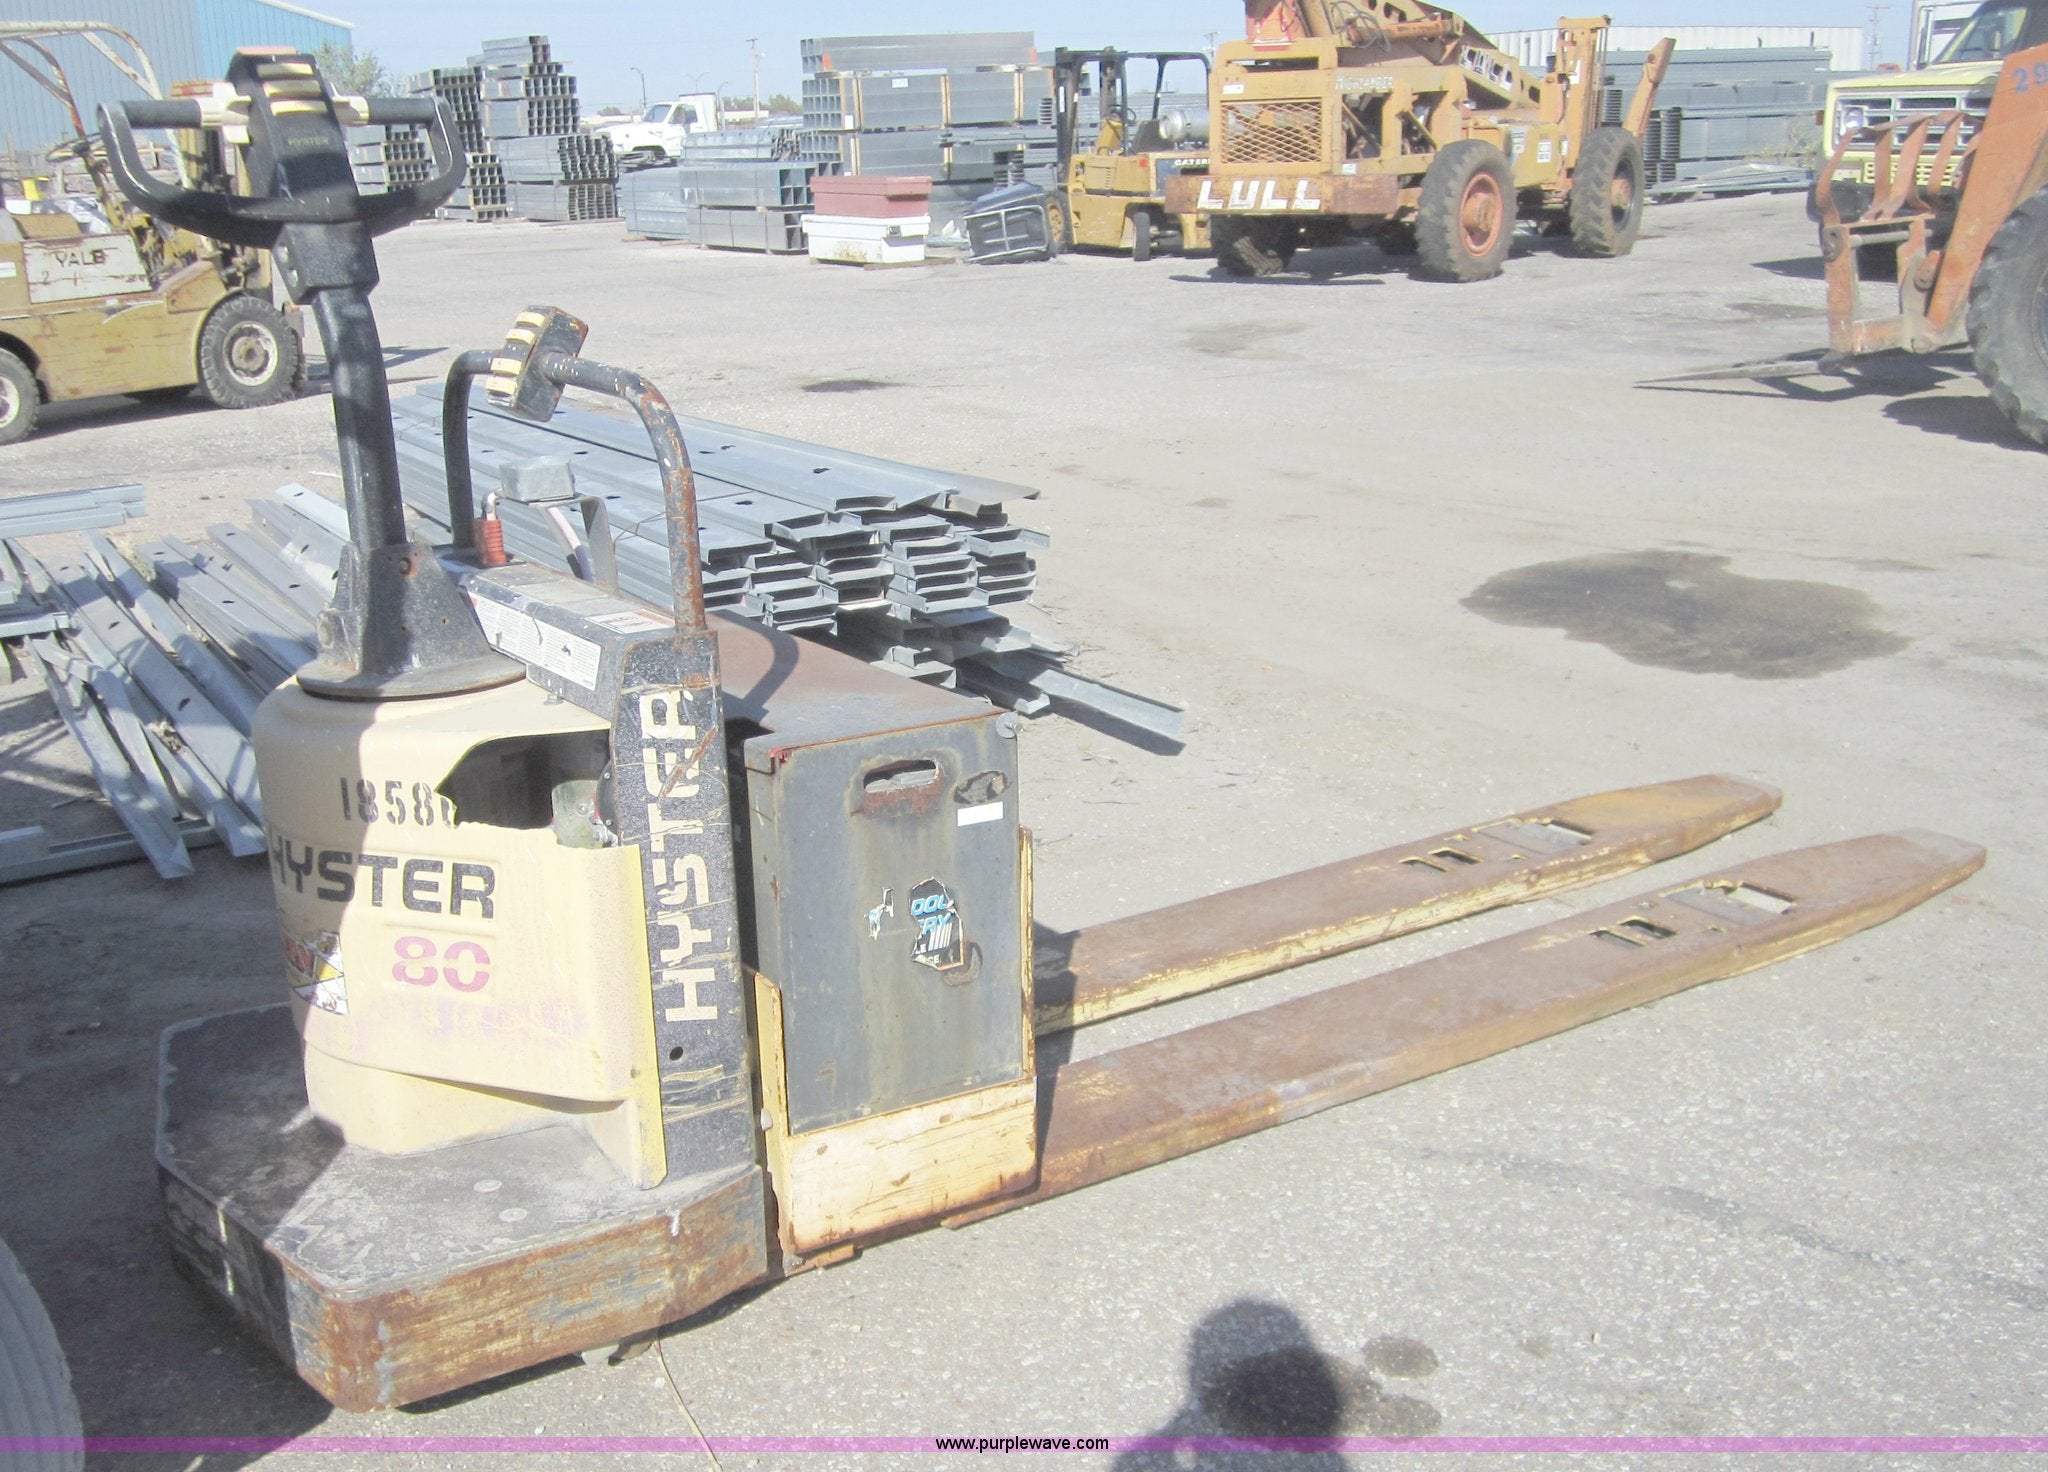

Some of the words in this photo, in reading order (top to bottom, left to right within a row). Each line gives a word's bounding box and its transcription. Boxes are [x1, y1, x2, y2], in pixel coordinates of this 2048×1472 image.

[1197, 180, 1321, 209] LULL
[269, 828, 495, 918] HYSTER
[639, 690, 718, 1022] HYSTER
[392, 936, 490, 993] 80
